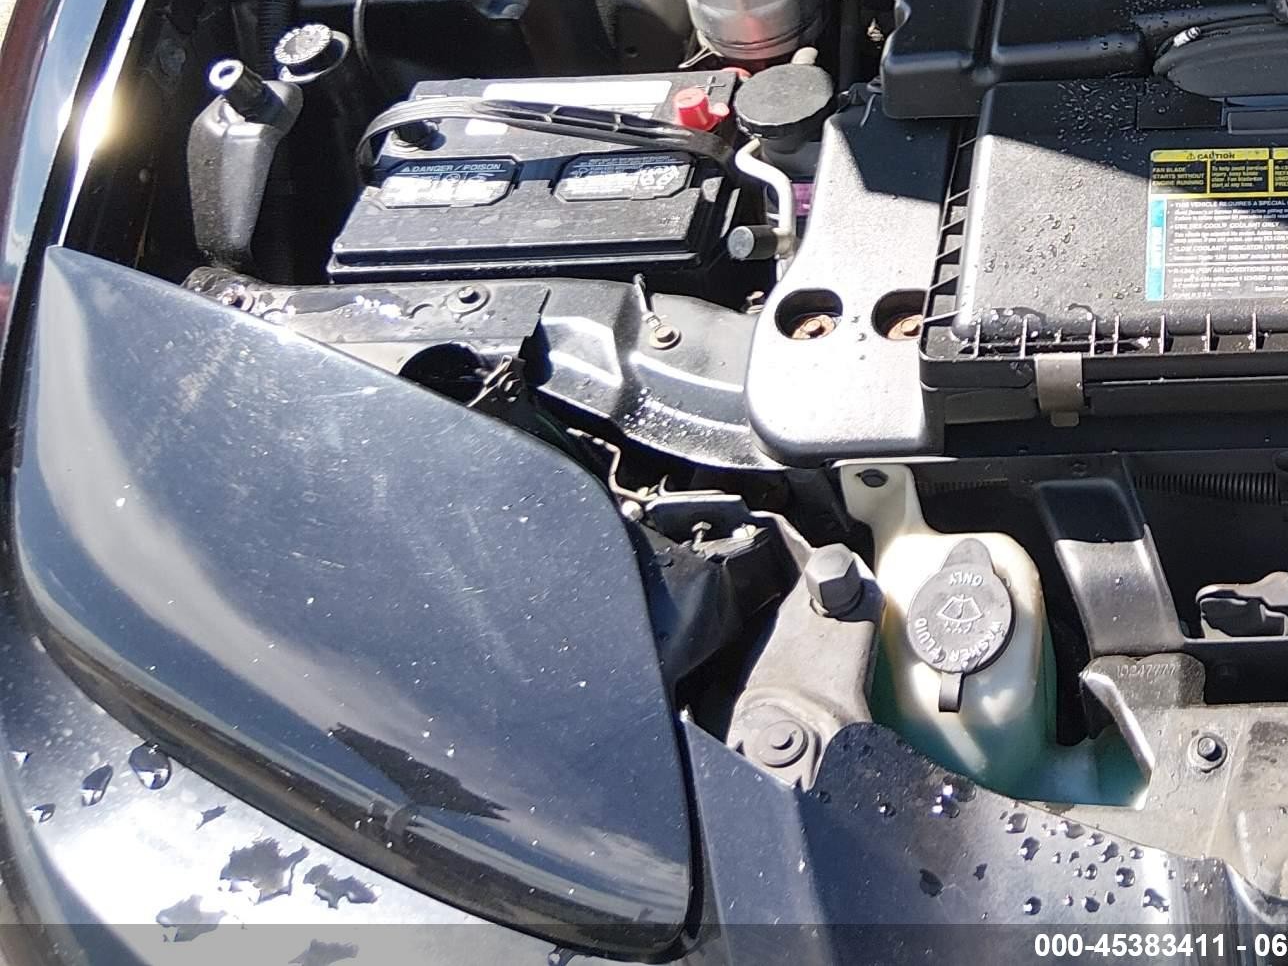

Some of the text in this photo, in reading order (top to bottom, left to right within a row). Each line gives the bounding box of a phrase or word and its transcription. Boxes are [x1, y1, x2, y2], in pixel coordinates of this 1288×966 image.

[463, 163, 501, 171] POISON
[950, 571, 983, 586] ONLY
[915, 617, 1004, 663] WASHER FLUID
